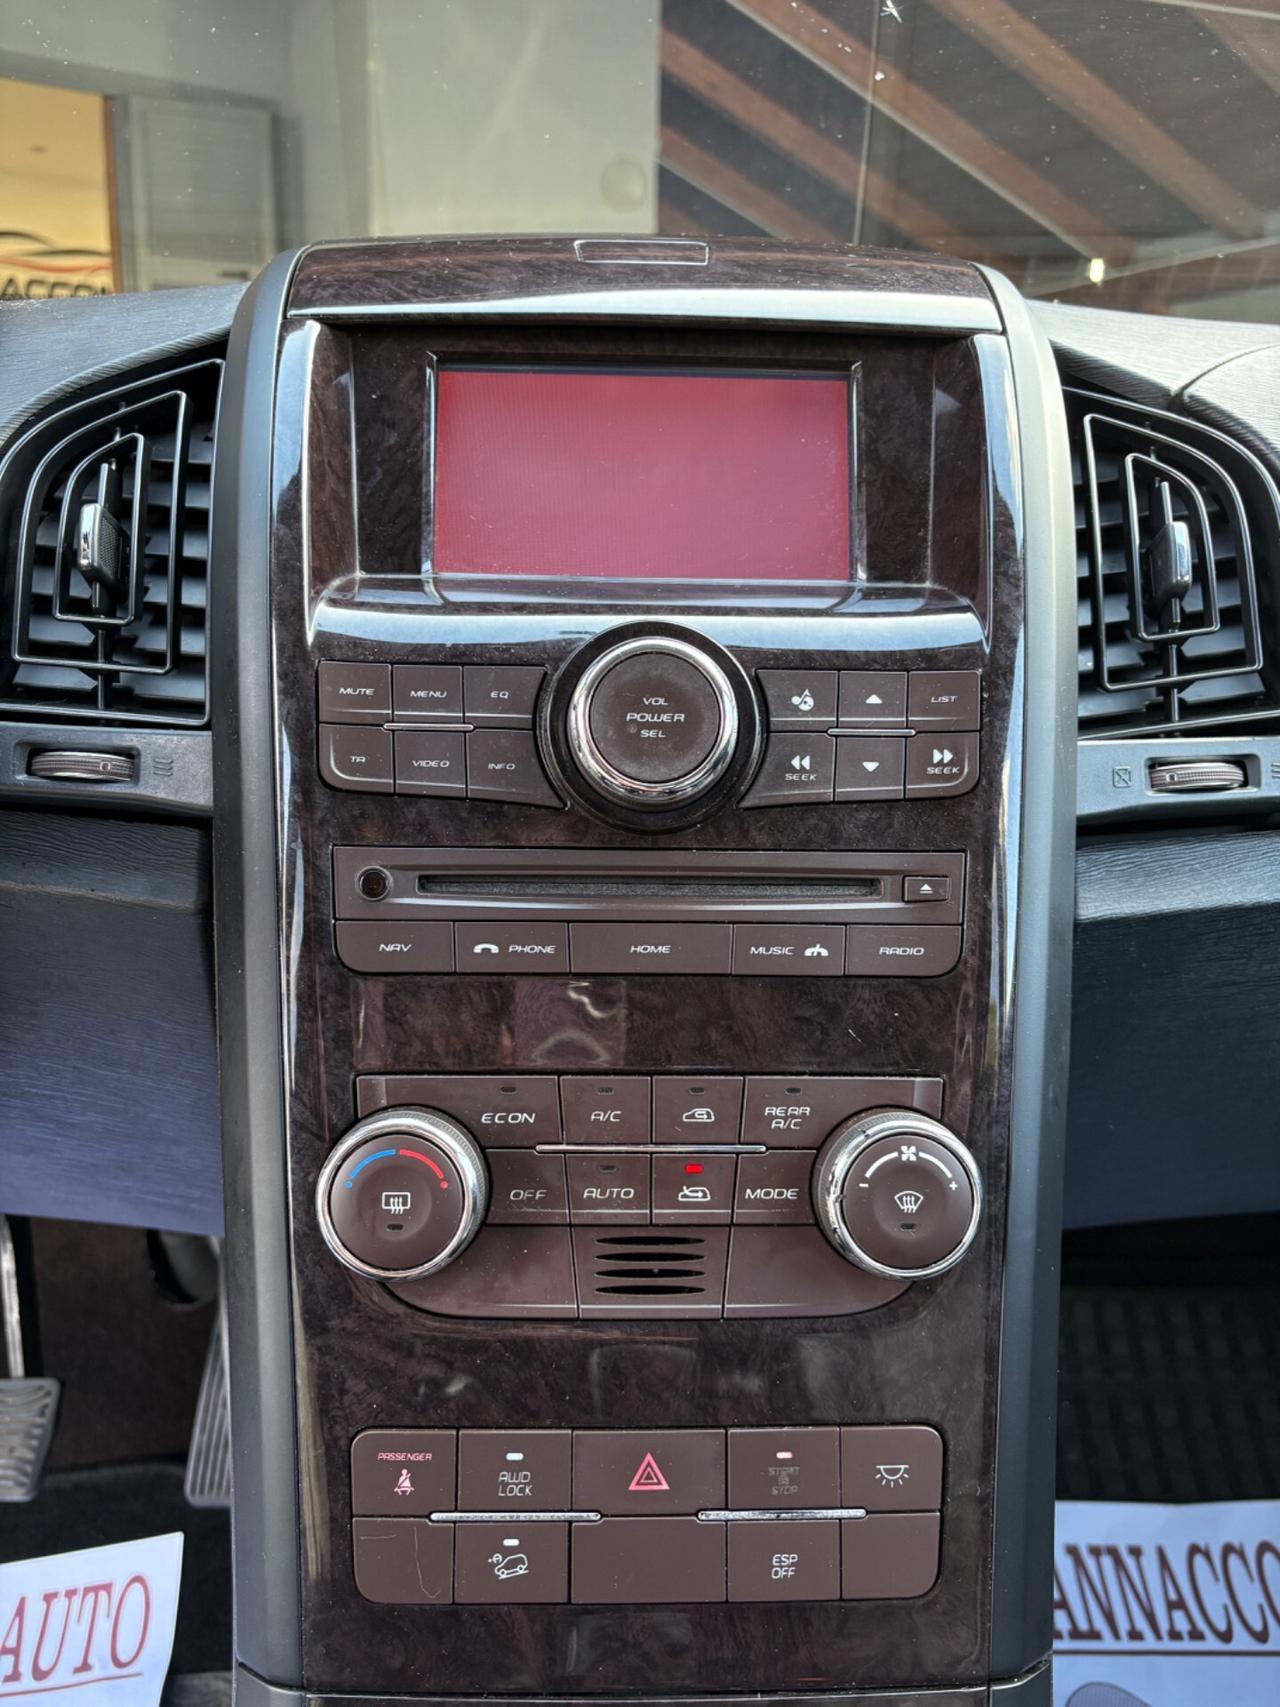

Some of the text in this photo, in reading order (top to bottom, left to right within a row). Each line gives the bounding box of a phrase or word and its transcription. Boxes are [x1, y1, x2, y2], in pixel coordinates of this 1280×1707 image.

[338, 687, 375, 696] MUTE
[409, 690, 448, 699] MENU
[490, 690, 510, 700] EQ
[642, 696, 669, 706] VOL
[930, 695, 958, 704] LIST
[625, 712, 686, 723] POWER
[640, 729, 666, 739] SEL
[411, 759, 451, 768] VIDEO
[487, 762, 516, 771] INFO
[926, 766, 960, 775] SEEK
[784, 772, 818, 782] SEEK
[378, 943, 412, 953] NAV
[508, 944, 557, 955] PHONE
[630, 944, 672, 955] HOME
[749, 946, 795, 956] MUSIC
[878, 946, 925, 956] RADIO
[590, 1110, 622, 1123] A/C
[764, 1106, 811, 1117] REAR
[480, 1112, 536, 1125] ECON
[770, 1117, 803, 1130] A/C
[509, 1189, 548, 1201] OFF
[583, 1187, 635, 1200] AUTO
[744, 1187, 799, 1200] MODE
[377, 1452, 433, 1462] PASSENGER
[498, 1471, 531, 1484] AWD
[497, 1484, 533, 1497] LOCK
[772, 1553, 799, 1566] ESP
[771, 1566, 796, 1580] OFF
[0, 1574, 151, 1683] AUTO
